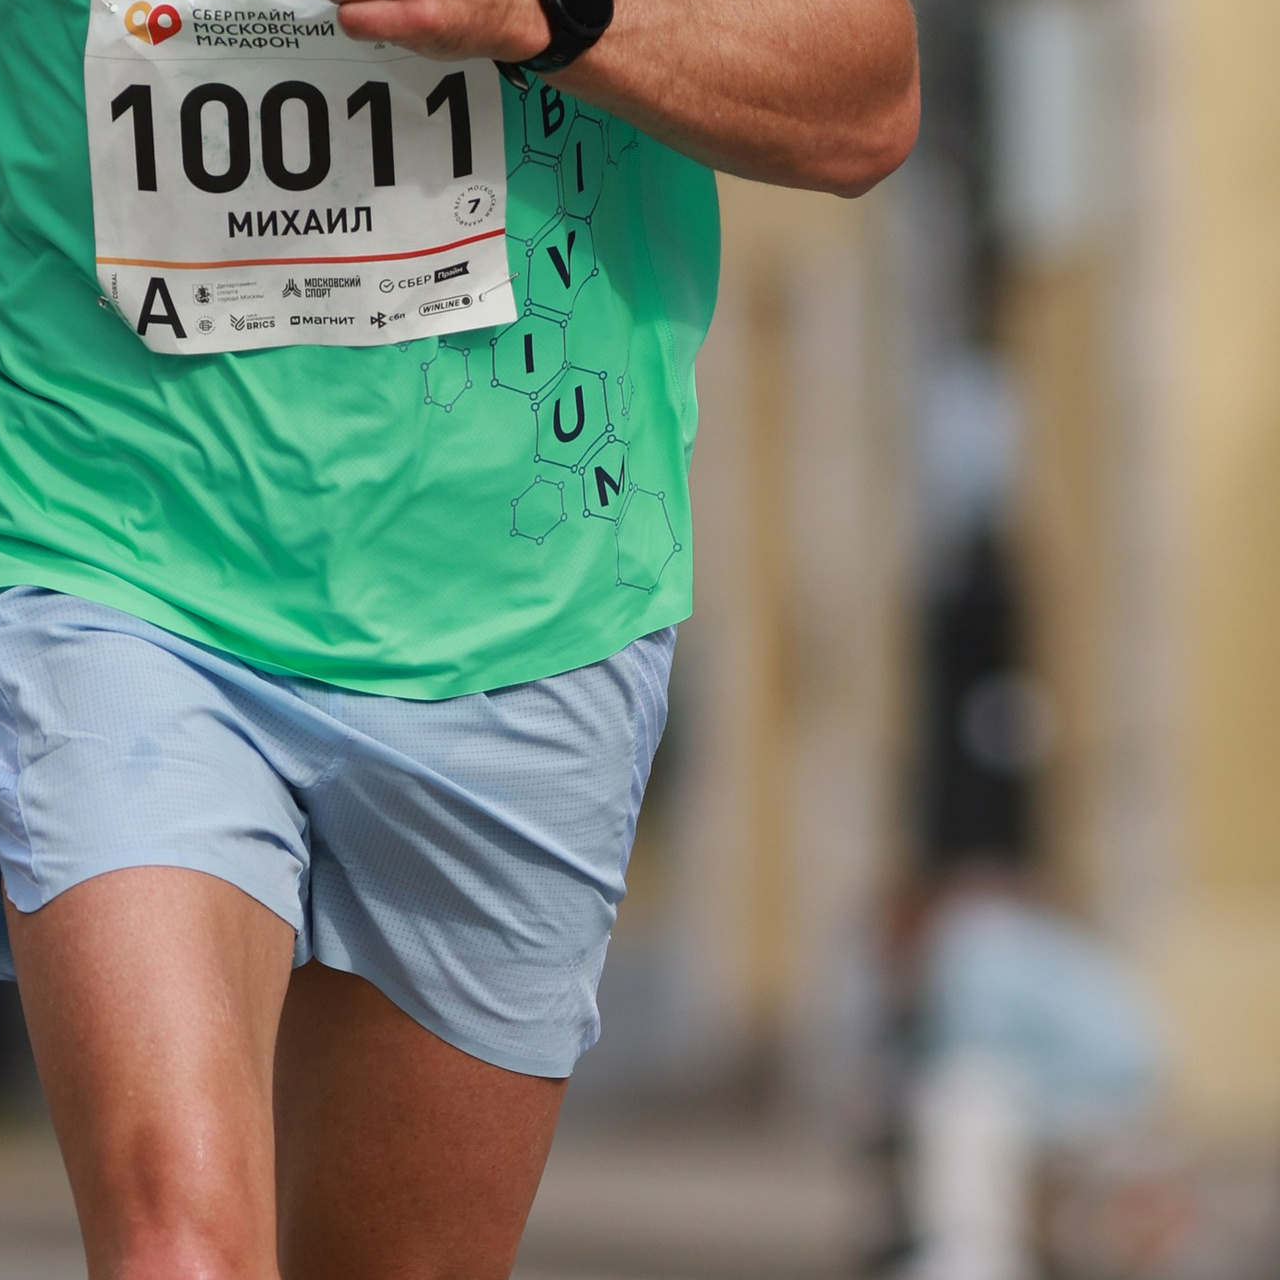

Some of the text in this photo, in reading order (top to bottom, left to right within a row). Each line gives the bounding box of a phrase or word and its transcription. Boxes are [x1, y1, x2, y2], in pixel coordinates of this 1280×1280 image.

[192, 8, 295, 21] СБЕРПРАЙМ
[193, 20, 335, 37] МОСКОВСКИЙ
[196, 35, 300, 49] МАРАФОН
[110, 71, 473, 194] 10011
[468, 197, 481, 214] 7
[228, 206, 373, 238] МИХАИЛ
[304, 275, 361, 288] МОСКОВСКИЙ
[398, 274, 432, 289] СБЕР
[305, 288, 331, 298] СПОРТ
[423, 299, 460, 313] WINLINE
[246, 320, 276, 330] BRICS
